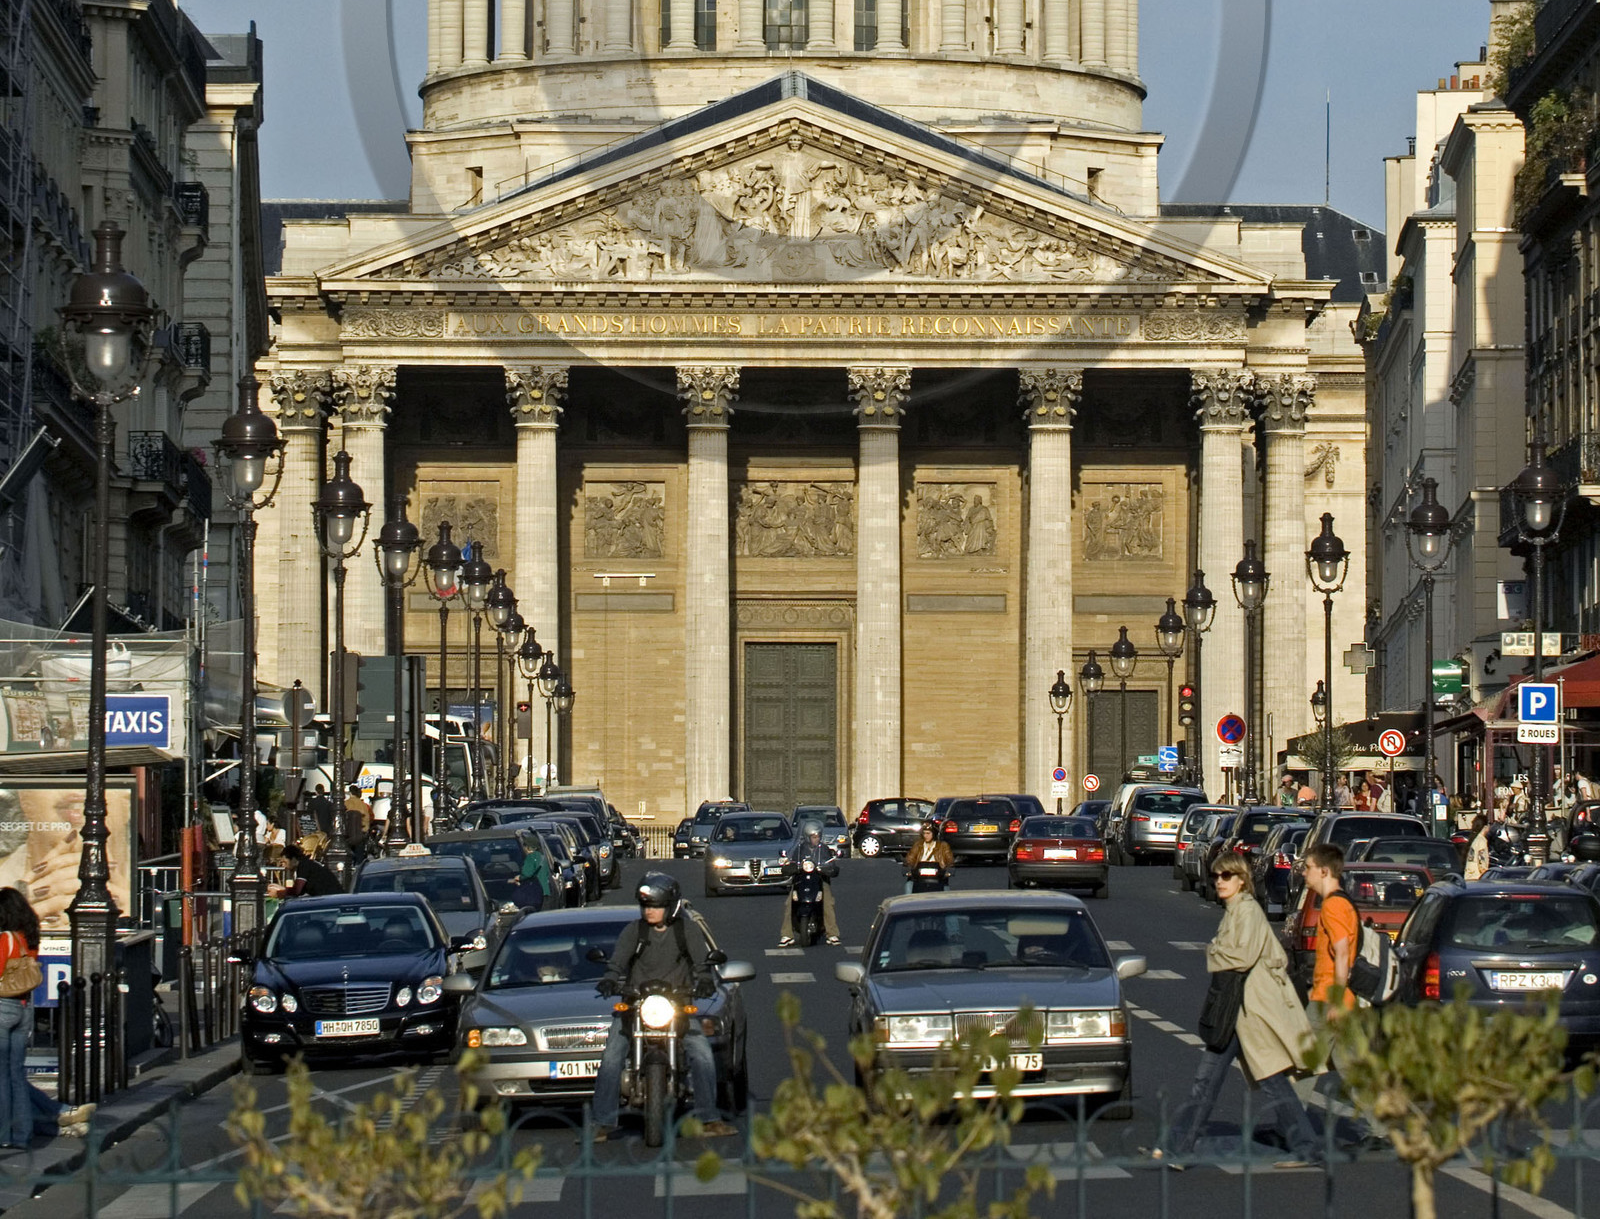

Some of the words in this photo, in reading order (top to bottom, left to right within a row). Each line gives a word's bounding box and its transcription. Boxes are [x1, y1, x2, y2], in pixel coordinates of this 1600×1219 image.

[454, 314, 509, 333] AUX
[517, 314, 624, 333] GRANDS
[630, 314, 742, 334] HOMMES
[759, 315, 790, 334] LA
[800, 315, 892, 335] PATRIE
[900, 315, 1132, 335] RECONNAISSANTE
[1530, 692, 1547, 715] P
[105, 711, 164, 734] TAXIS
[1520, 730, 1526, 738] 2
[1528, 729, 1556, 738] ROUES
[1513, 774, 1529, 782] LES
[0, 821, 35, 832] SECRET
[37, 821, 50, 832] DE
[51, 821, 71, 832] PRO
[1500, 974, 1527, 987] RPZ
[1024, 1055, 1038, 1069] 75
[560, 1063, 580, 1076] 401
